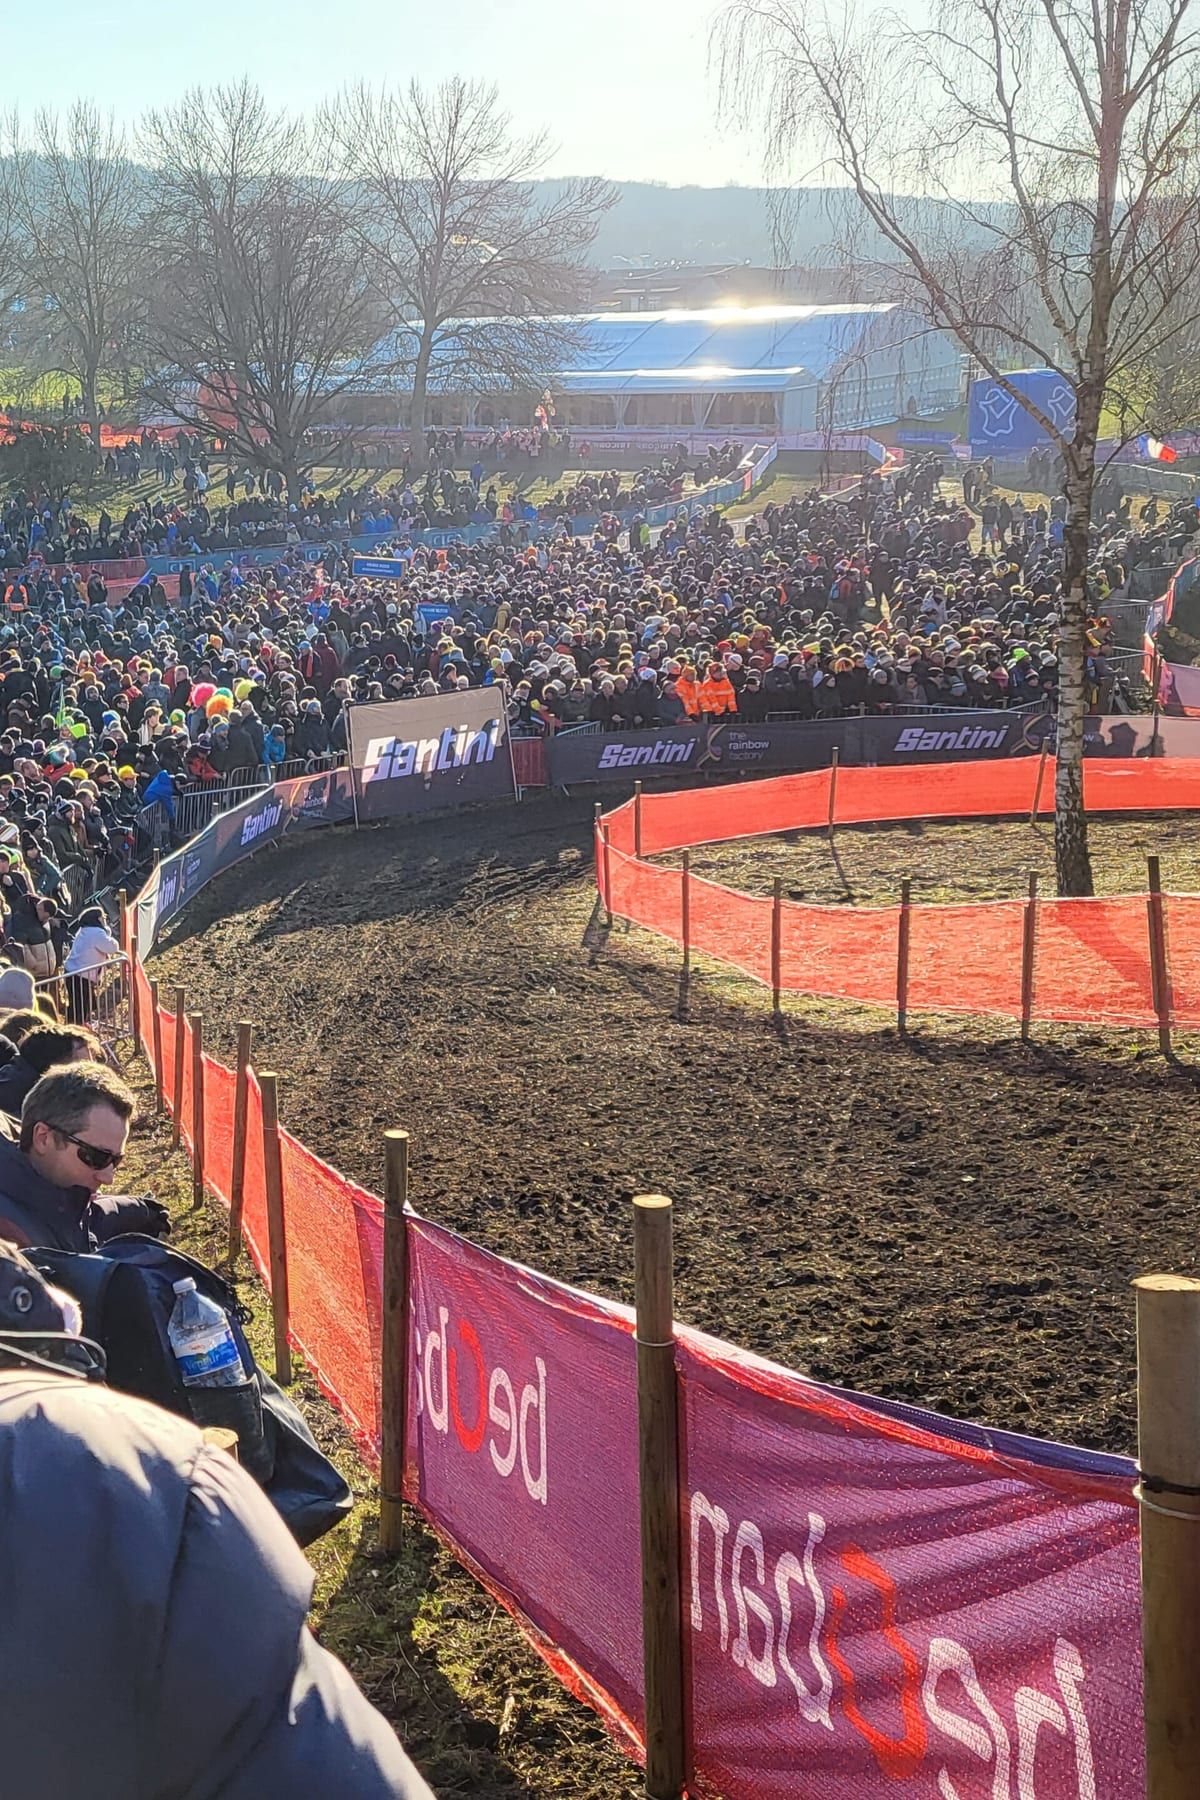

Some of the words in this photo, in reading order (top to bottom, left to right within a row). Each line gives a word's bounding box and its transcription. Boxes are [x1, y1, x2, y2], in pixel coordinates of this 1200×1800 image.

[361, 719, 501, 784] Santini
[598, 738, 696, 769] Santini
[728, 740, 770, 750] rainbow
[894, 725, 1009, 752] Santini
[240, 799, 284, 846] Santini
